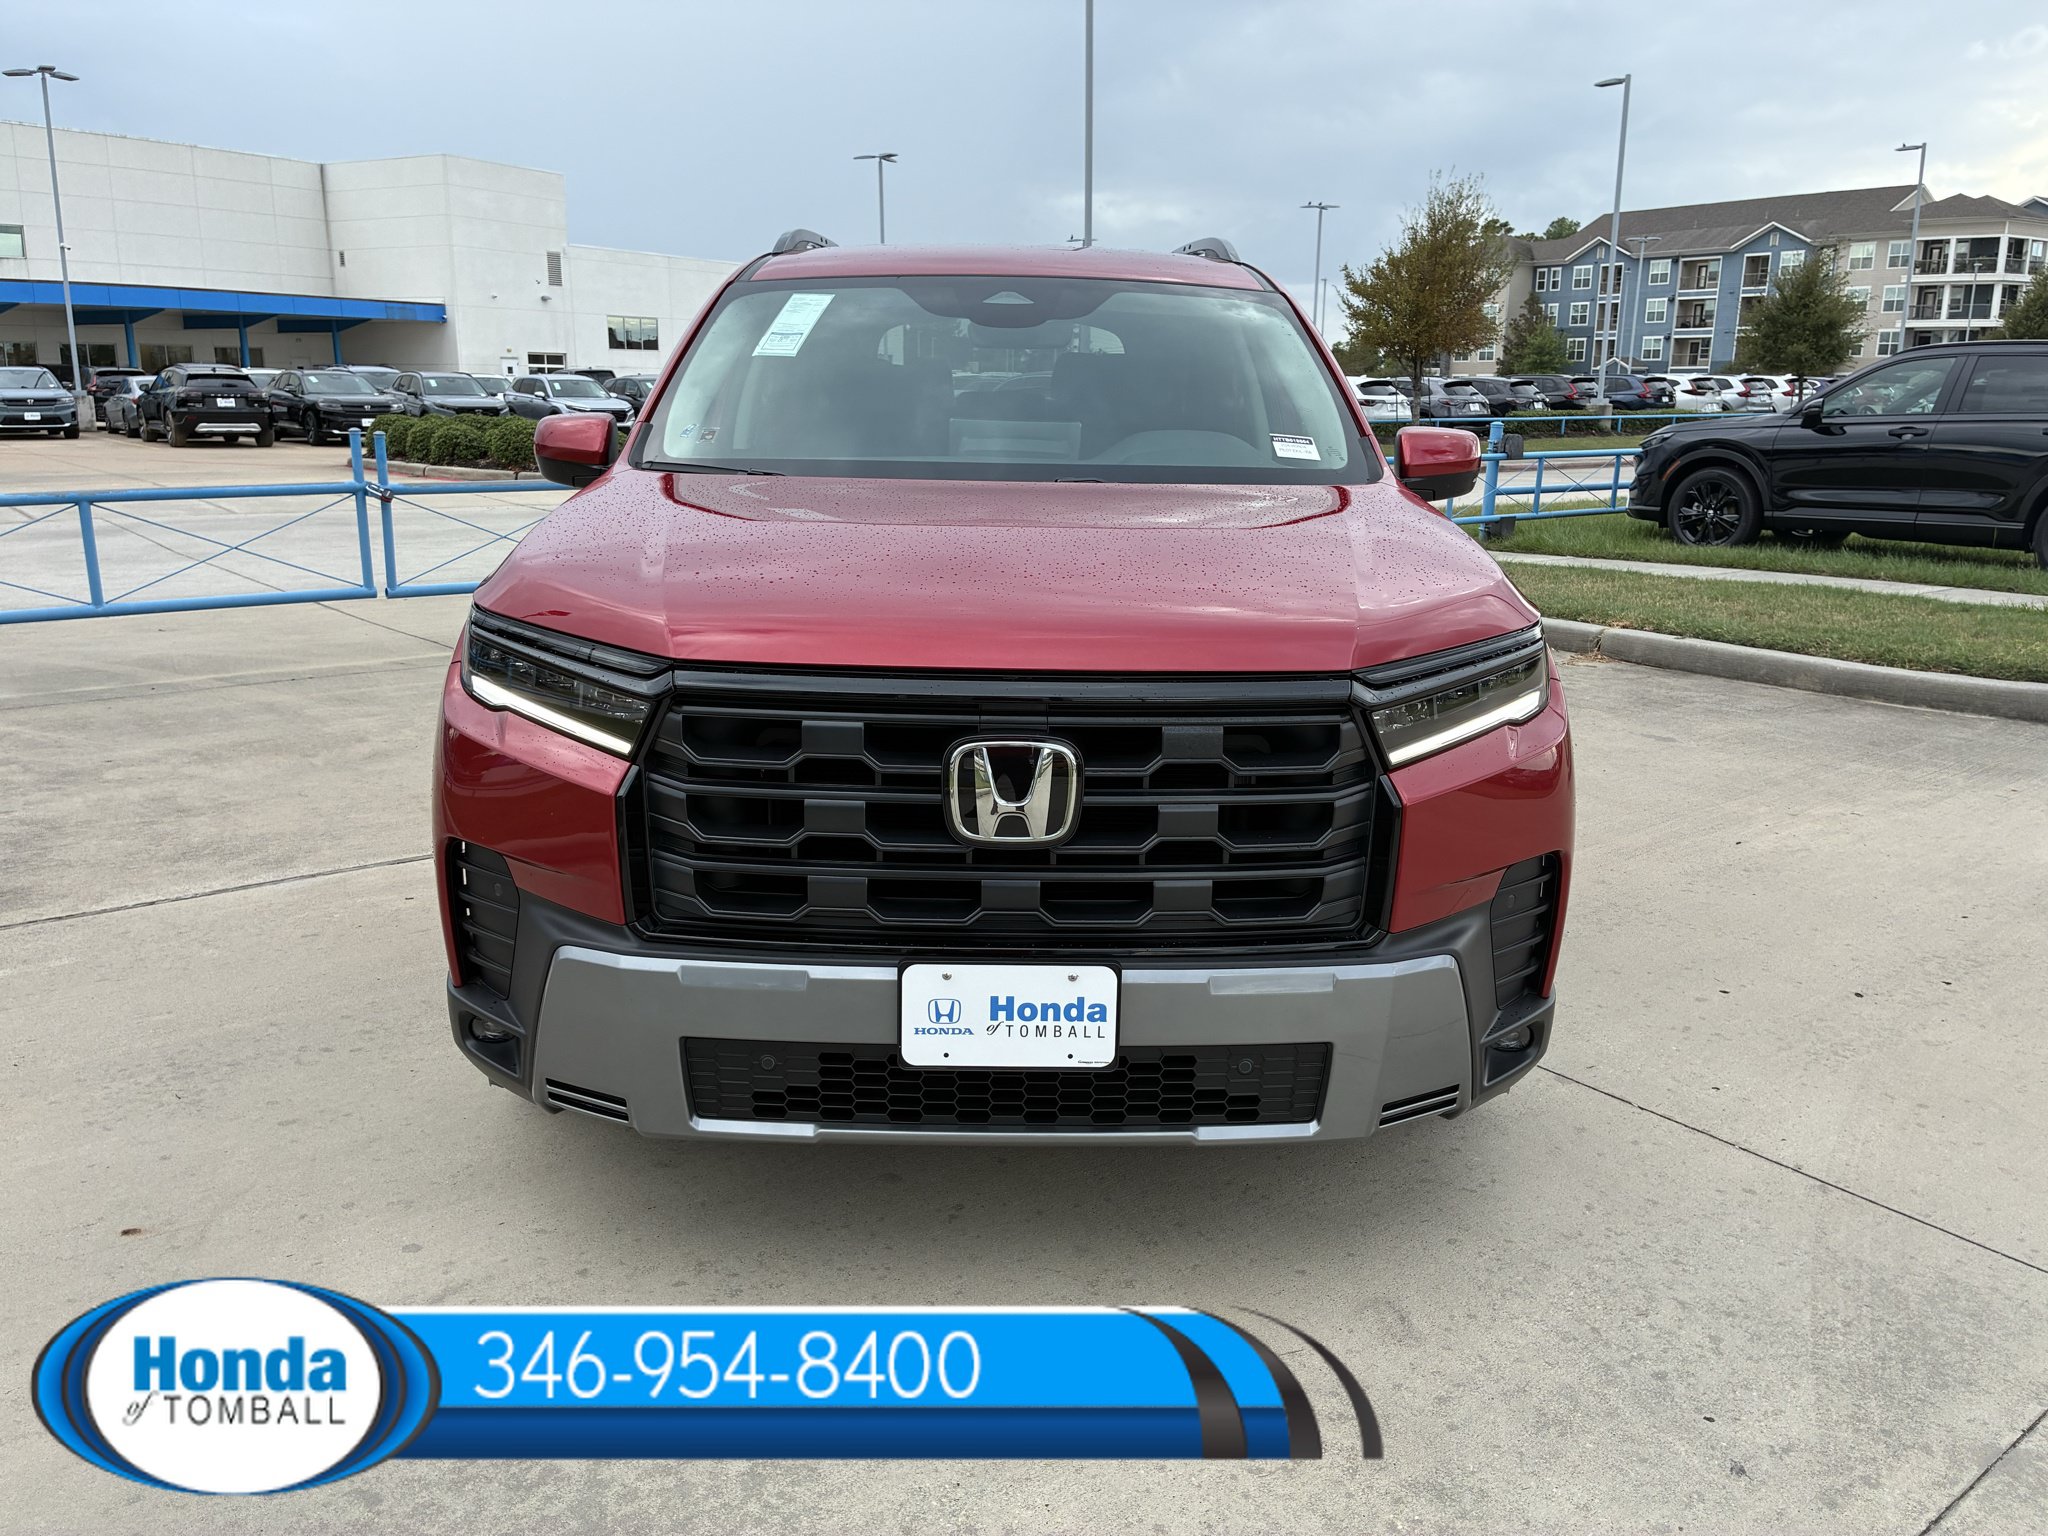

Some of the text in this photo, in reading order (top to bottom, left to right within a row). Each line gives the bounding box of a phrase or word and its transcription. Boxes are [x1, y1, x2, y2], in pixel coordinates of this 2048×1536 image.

[990, 996, 1107, 1022] Honda
[986, 1021, 1105, 1038] of TOMBALL
